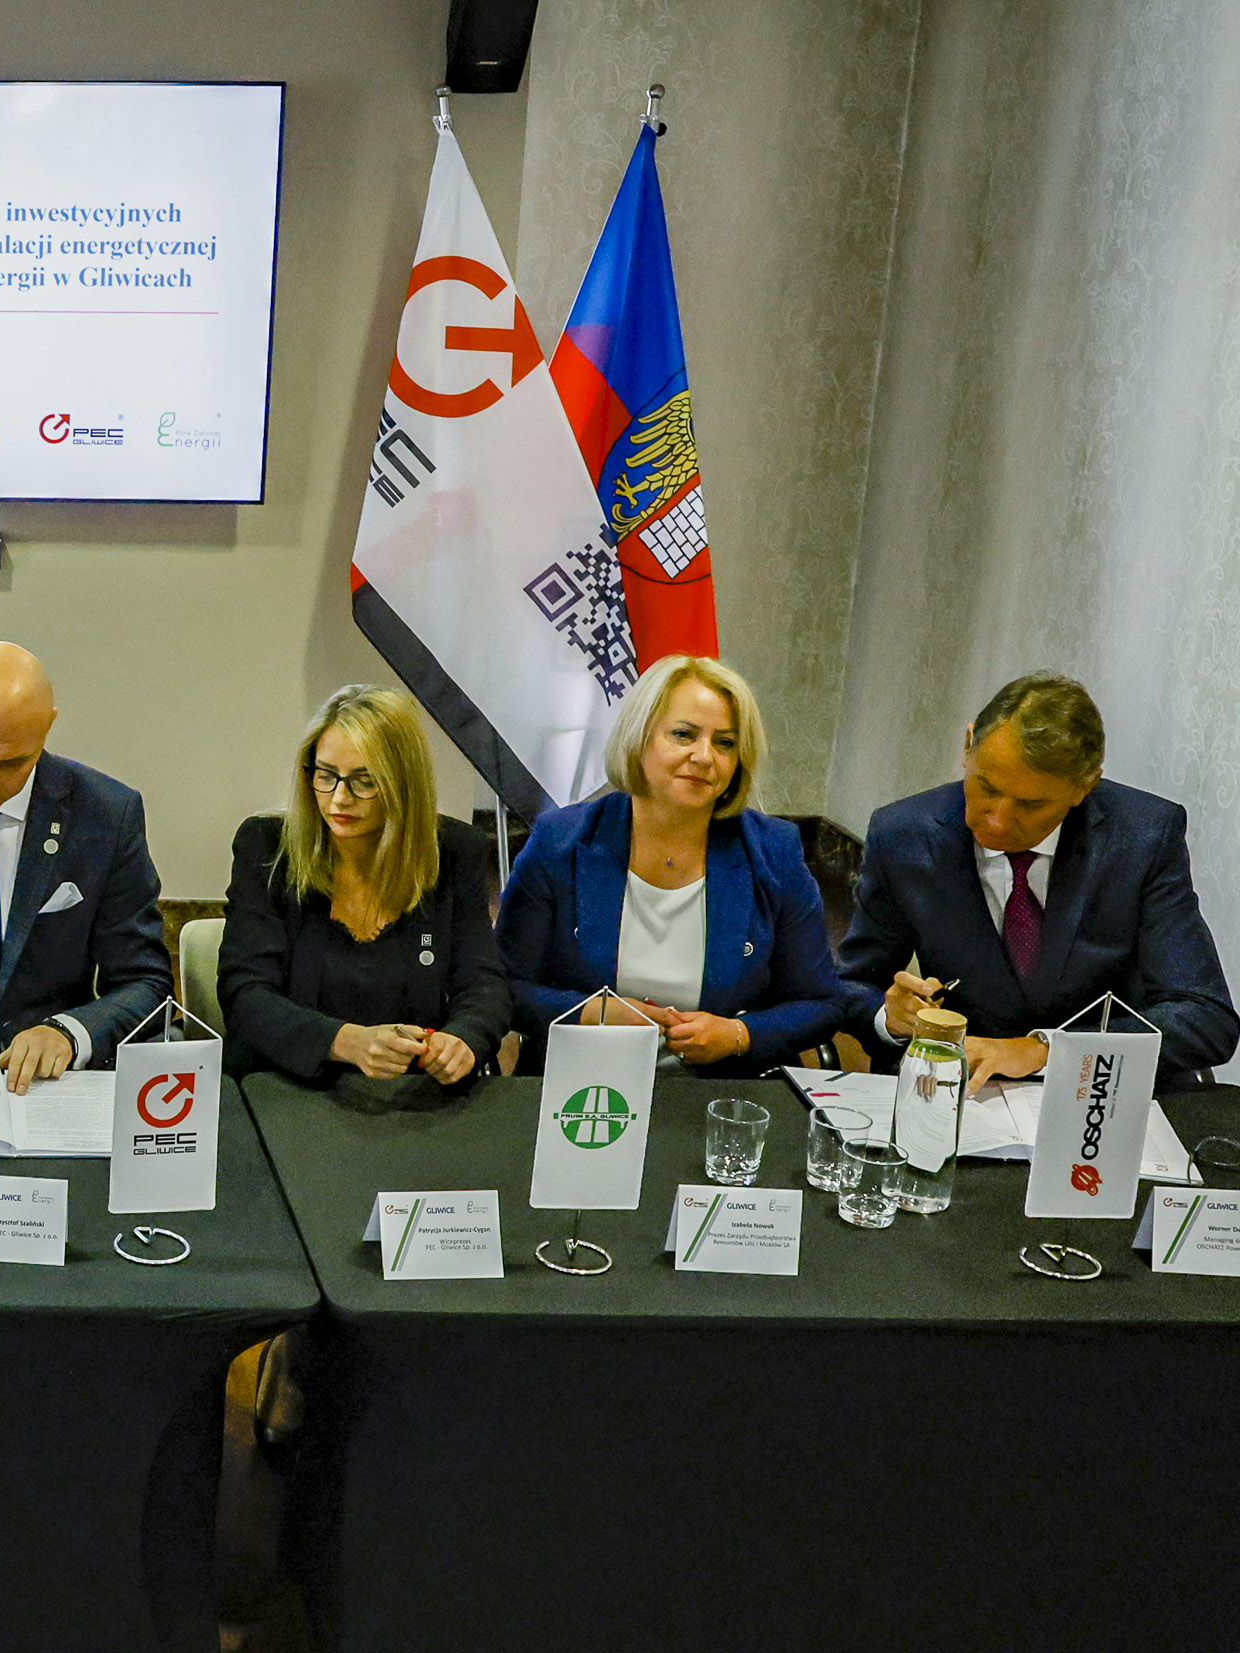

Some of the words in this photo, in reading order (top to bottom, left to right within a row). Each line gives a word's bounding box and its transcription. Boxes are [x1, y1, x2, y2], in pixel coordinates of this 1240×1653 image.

[6, 202, 181, 228] inwestycyjnych
[60, 236, 216, 261] energetycznej
[53, 272, 71, 286] w
[79, 266, 193, 288] Gliwicach
[72, 428, 124, 438] PEC
[1080, 1054, 1093, 1085] YEARS
[1081, 1054, 1114, 1160] OSCHATZ
[133, 1132, 197, 1147] PEC
[133, 1146, 197, 1156] GLIWICE
[726, 1202, 757, 1211] GLIWICE
[1207, 1203, 1239, 1211] GLIWICE
